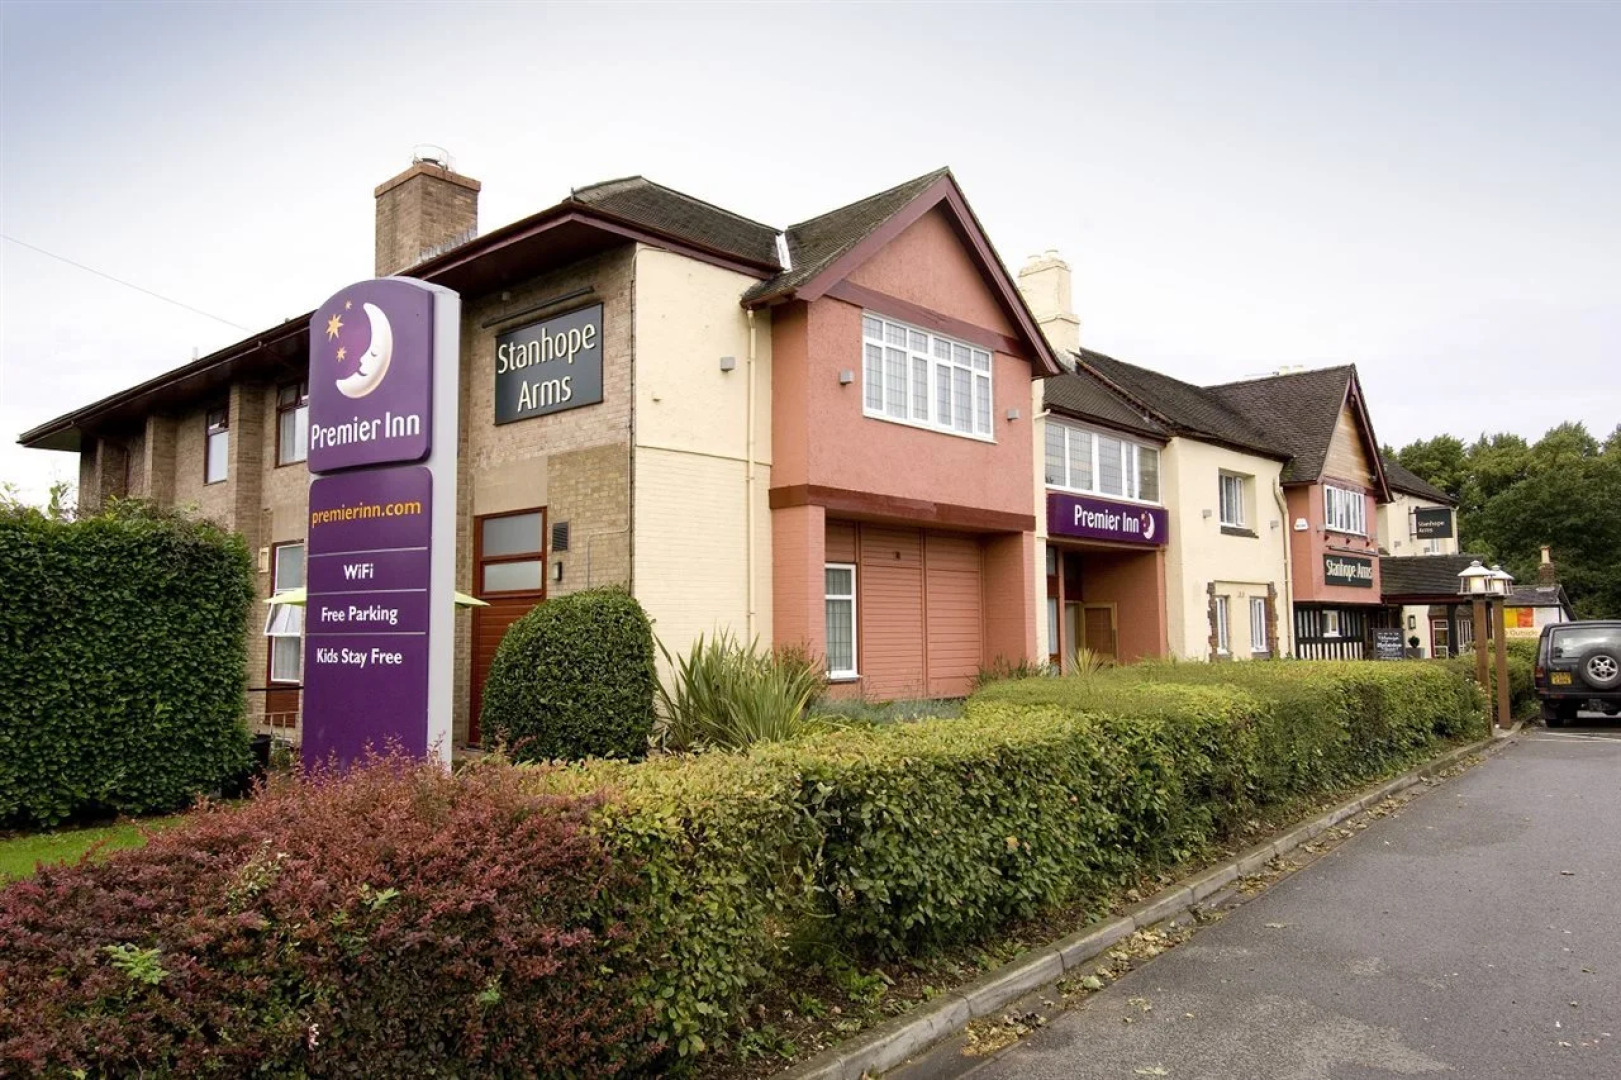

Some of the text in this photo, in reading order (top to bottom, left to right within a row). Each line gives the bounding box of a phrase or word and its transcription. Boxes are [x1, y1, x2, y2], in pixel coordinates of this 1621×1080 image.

[498, 323, 596, 374] Stanhope
[517, 375, 572, 413] Arms
[311, 411, 420, 450] Premier Inn
[312, 501, 421, 528] premierinn.com
[1074, 504, 1140, 533] Premier Inn
[343, 563, 374, 580] WiFi
[1326, 558, 1373, 582] Stanhope Arms
[321, 605, 398, 625] Free Parking
[317, 647, 403, 669] Kids Stay Free
